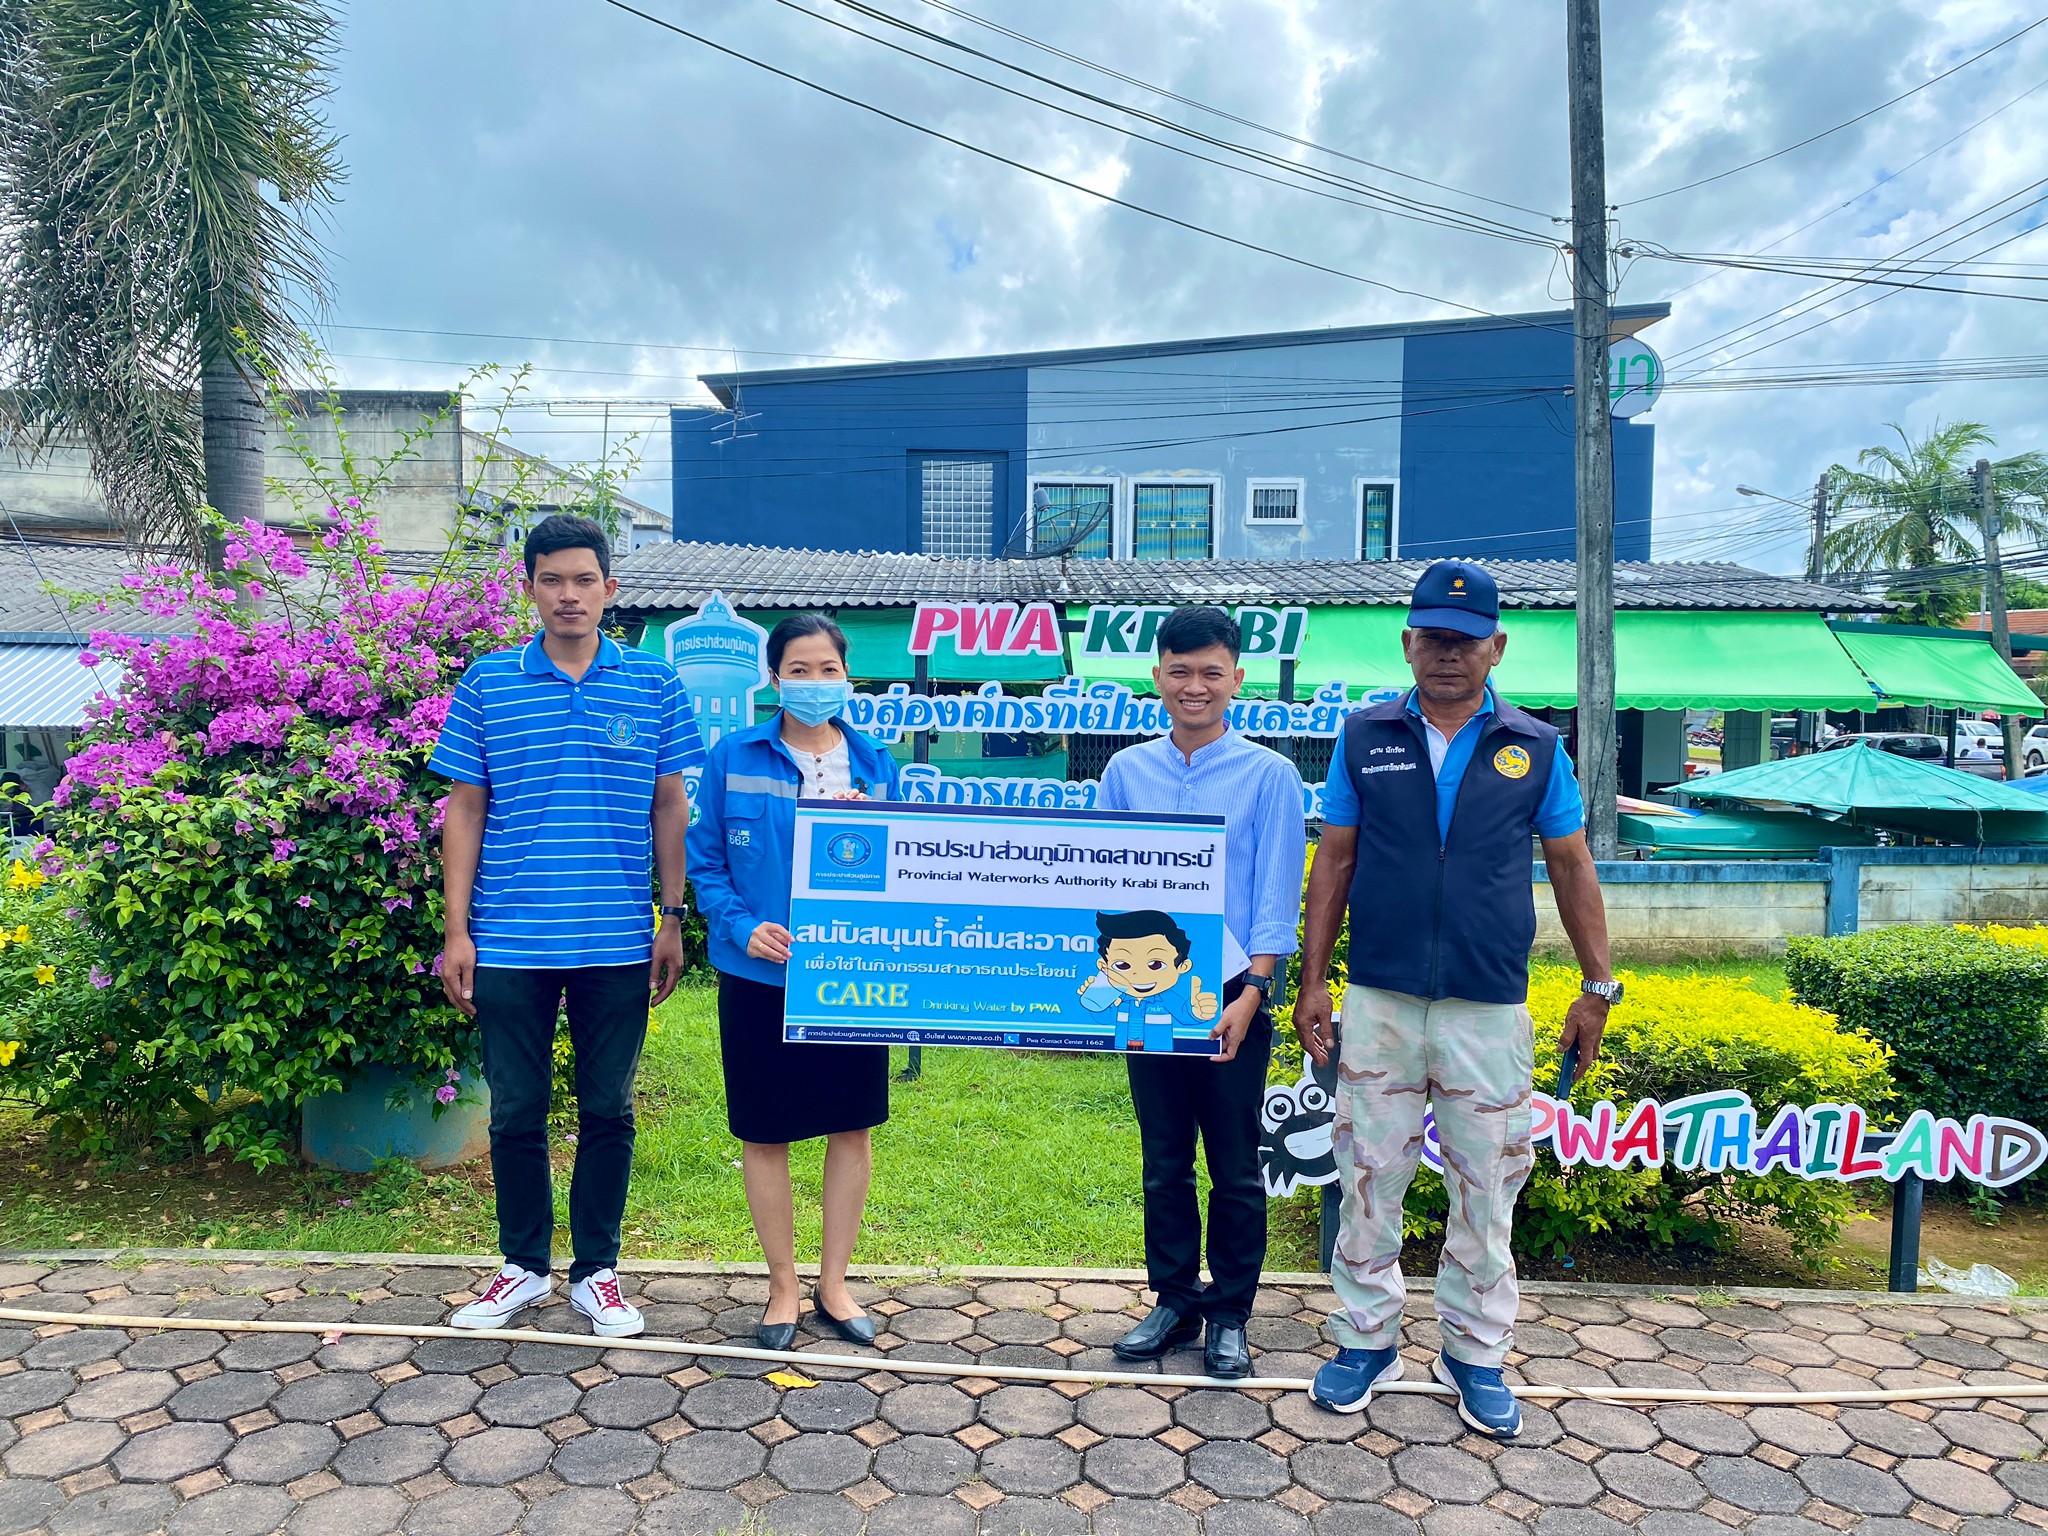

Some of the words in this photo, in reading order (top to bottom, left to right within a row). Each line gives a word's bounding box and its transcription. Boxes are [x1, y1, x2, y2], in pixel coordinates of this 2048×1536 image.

[912, 607, 1059, 652] PWA
[1086, 610, 1303, 655] KBI
[675, 633, 756, 656] การประปาส่วนภูมิภาค
[729, 835, 750, 846] 662
[895, 839, 1215, 868] การประปาส่วนภูมิภาคสาขากระบี่
[898, 869, 962, 881] Provincial
[968, 871, 1049, 885] Waterworks
[1054, 875, 1117, 889] Authority
[1122, 877, 1157, 888] Krabi
[1163, 879, 1210, 891] Branch
[796, 915, 1095, 953] สนับสนุนน้ำดื่มสะอาด
[805, 952, 1077, 978] เพื่อใช้ในกิจกรรมสาธารณประโยชน์
[816, 980, 909, 1007] CARE
[922, 999, 970, 1012] Drinking
[973, 1001, 1006, 1011] Water
[1011, 1002, 1025, 1014] by
[1029, 1003, 1061, 1013] PWA
[947, 1033, 1002, 1042] www.pwa.co.th
